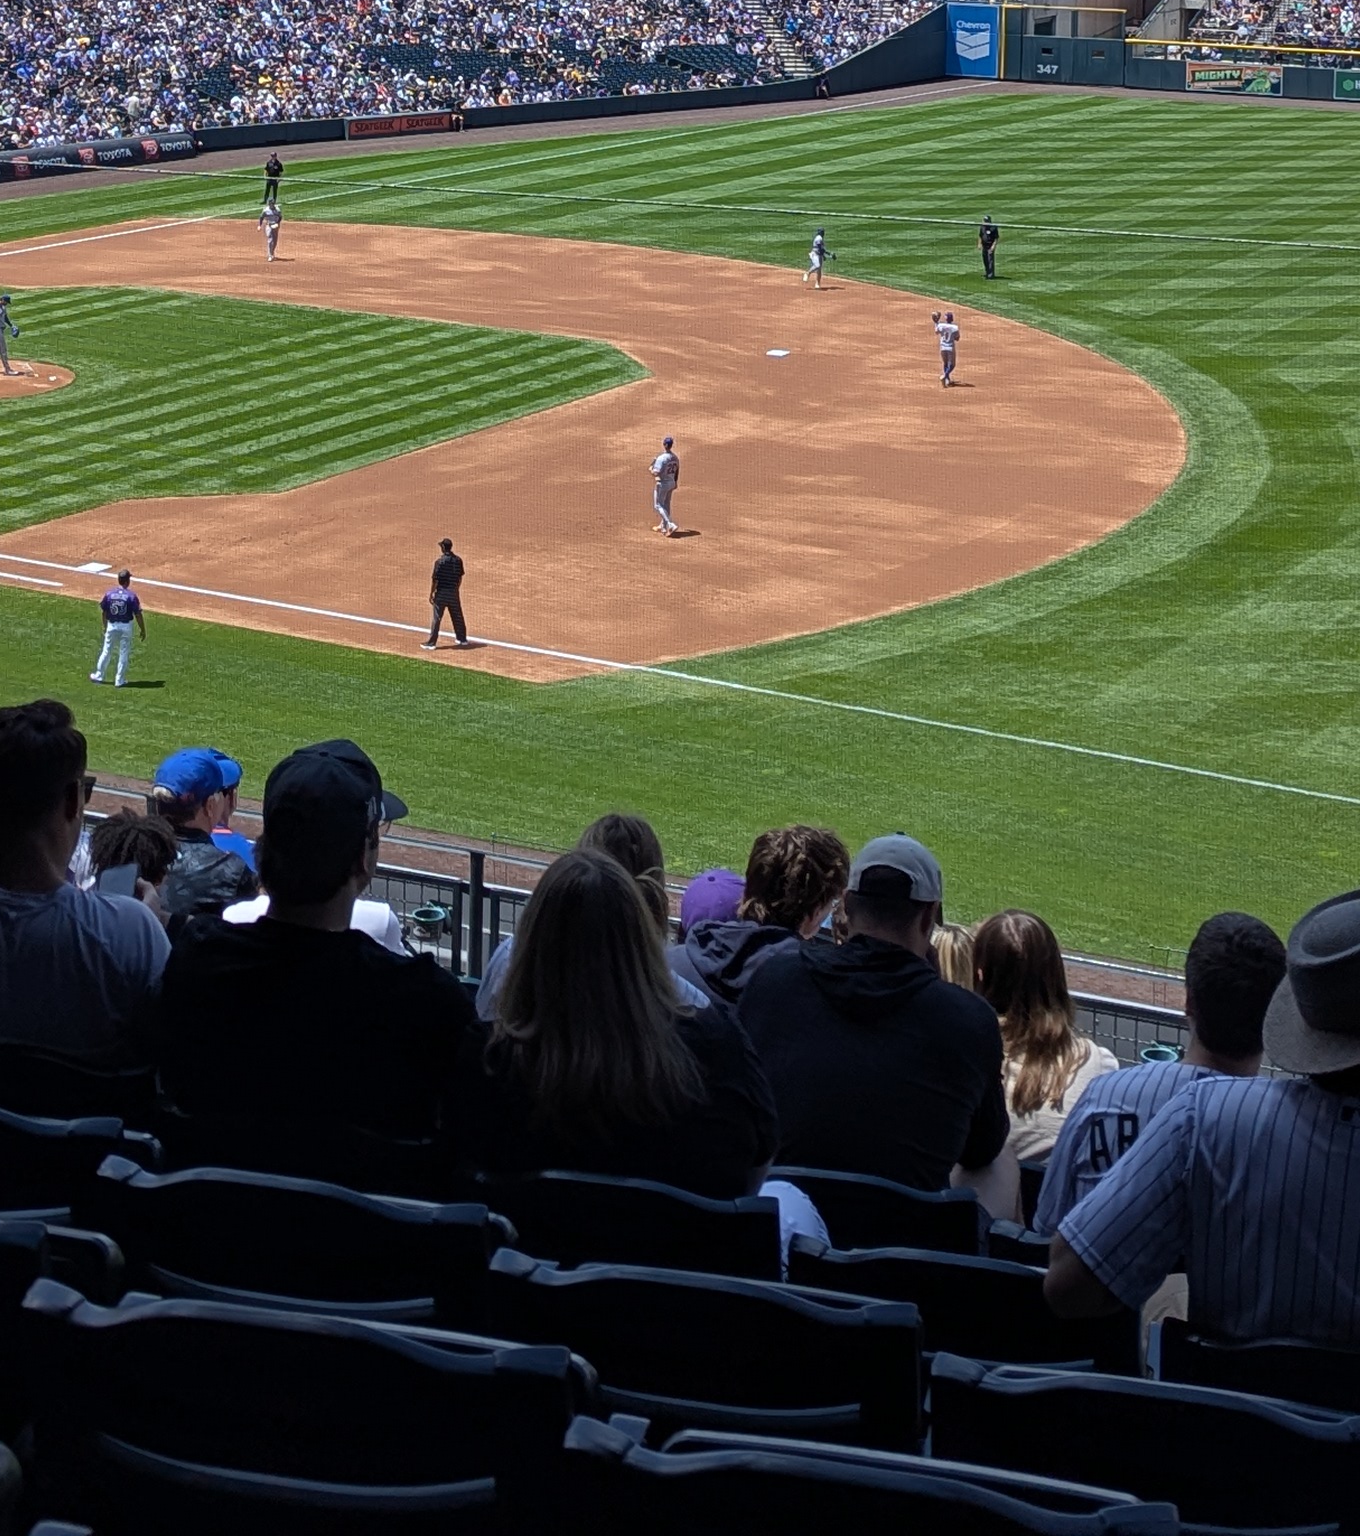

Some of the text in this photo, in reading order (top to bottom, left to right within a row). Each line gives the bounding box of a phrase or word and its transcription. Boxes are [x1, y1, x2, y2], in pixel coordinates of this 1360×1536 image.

[956, 19, 991, 30] Chevron
[1036, 63, 1058, 75] 347
[1194, 70, 1240, 81] MIGHTY
[160, 141, 193, 153] TOYOTA
[97, 148, 133, 162] TOYOTA
